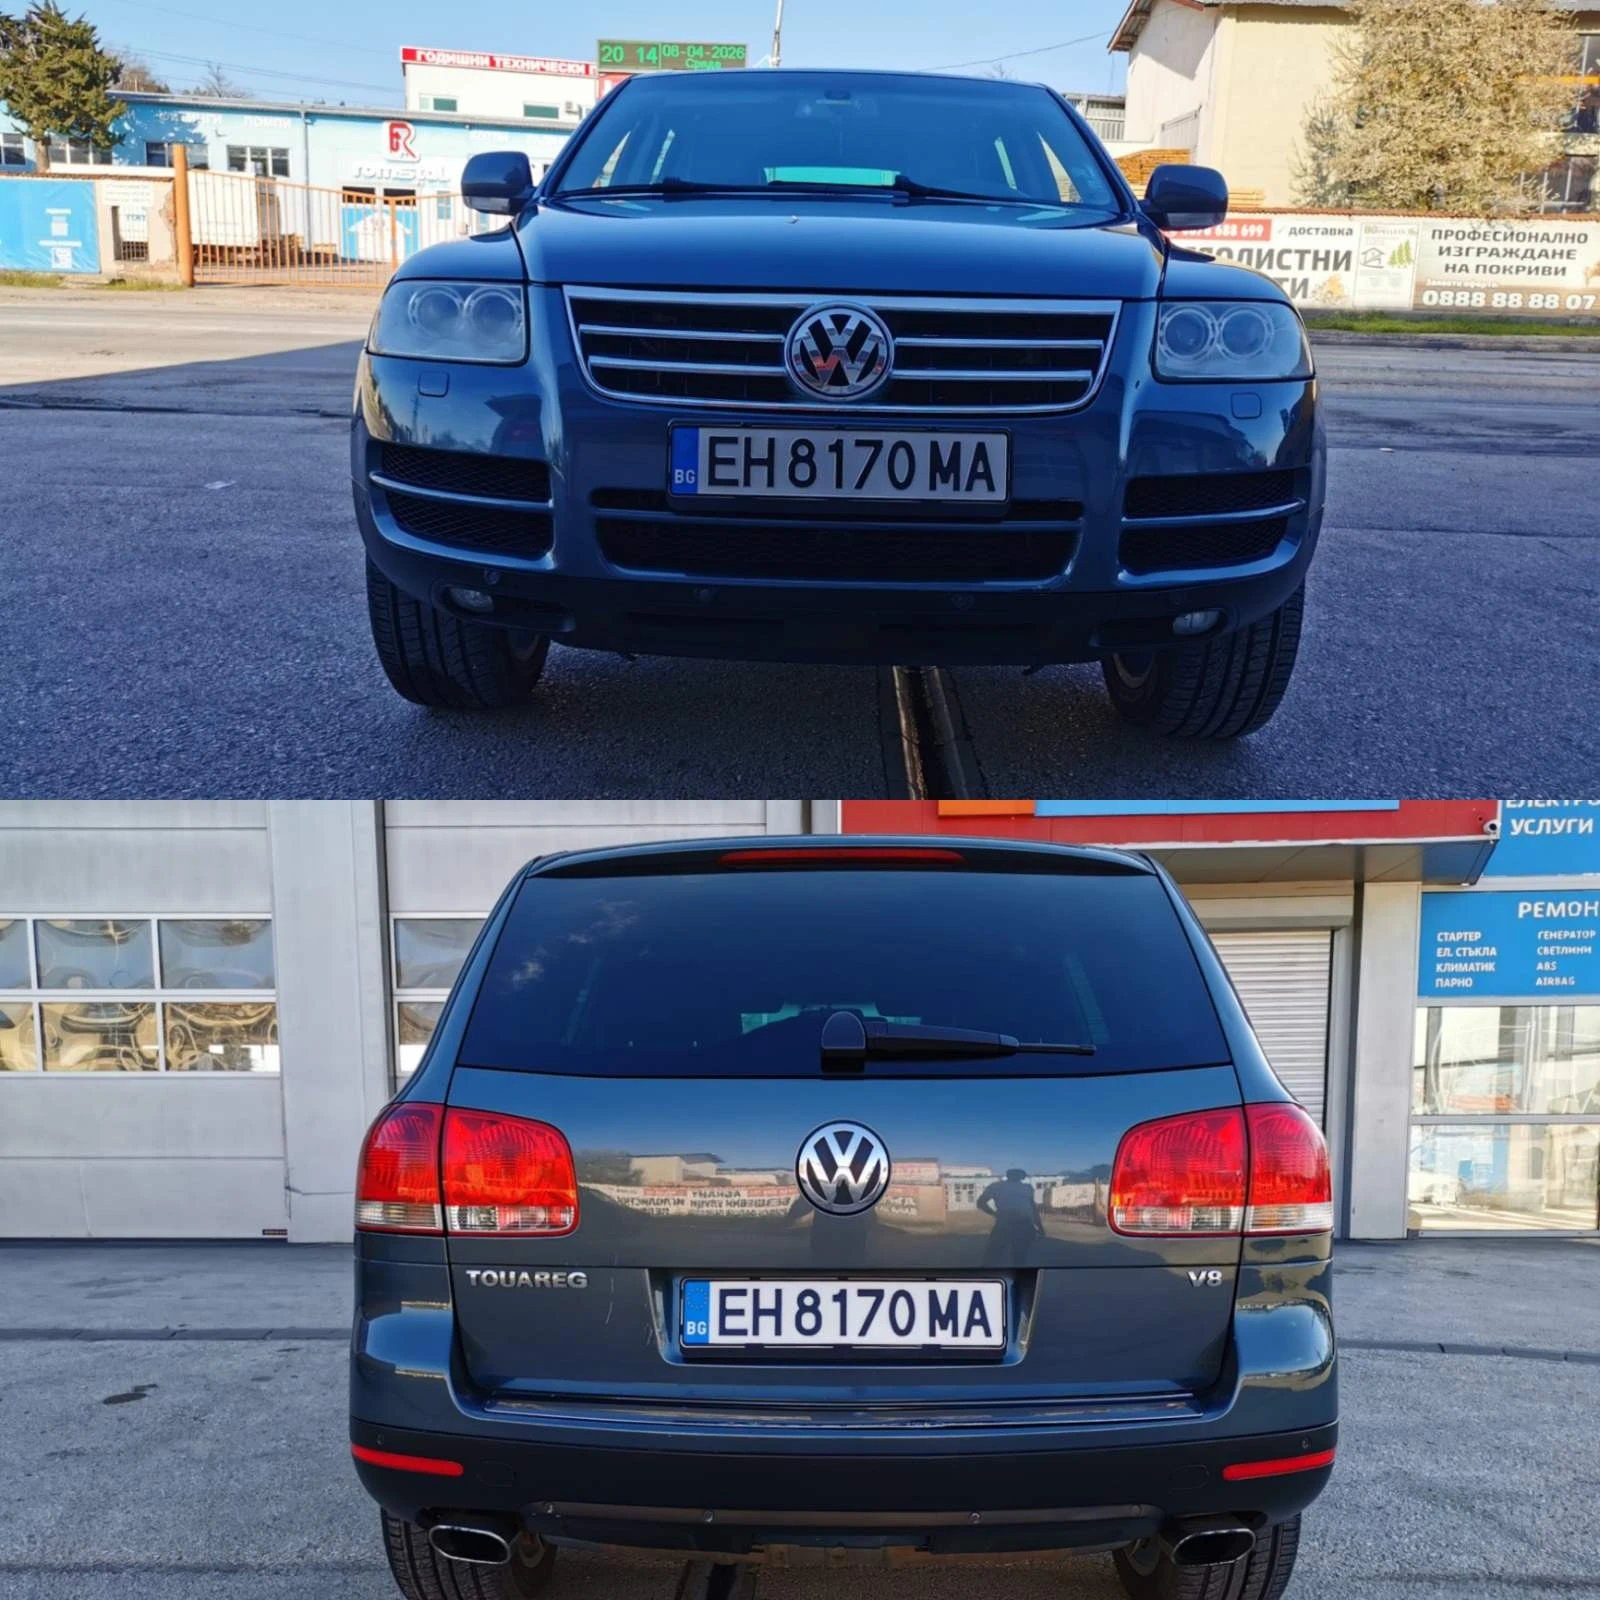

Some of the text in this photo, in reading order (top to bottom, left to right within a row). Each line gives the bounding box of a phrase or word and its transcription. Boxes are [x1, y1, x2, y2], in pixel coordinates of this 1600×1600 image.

[601, 46, 658, 64] 20 14
[416, 50, 490, 67] ГОДИШНИ
[491, 56, 585, 75] ТЕХНИЧЕСКИ
[1241, 224, 1264, 238] 699
[1288, 226, 1353, 237] доставка
[1431, 228, 1588, 244] ПРОФЕСИОНАЛНО
[1438, 245, 1577, 261] ИЗГРАЖДАНЕ
[1444, 263, 1567, 277] НА ПОКРИВИ
[1422, 290, 1597, 310] 0888 88 88 07
[674, 469, 696, 484] BG
[1510, 818, 1594, 836] УСЛУГИ
[1518, 901, 1600, 919] РЕМОН
[1436, 931, 1482, 942] СТАРТЕР
[1537, 929, 1597, 940] ГЕНЕРАТОР
[1436, 946, 1497, 957] ЕЛ. СТЪКЛА
[1537, 945, 1592, 956] СВЕТЛИНИ
[1436, 961, 1496, 973] КЛИМАТИК
[1536, 960, 1557, 971] ABS
[1435, 977, 1473, 988] ПАРНО
[1535, 976, 1575, 987] AIRBAG
[466, 1270, 588, 1288] TOUAREG
[1187, 1270, 1222, 1287] V8
[686, 1321, 707, 1335] BG
